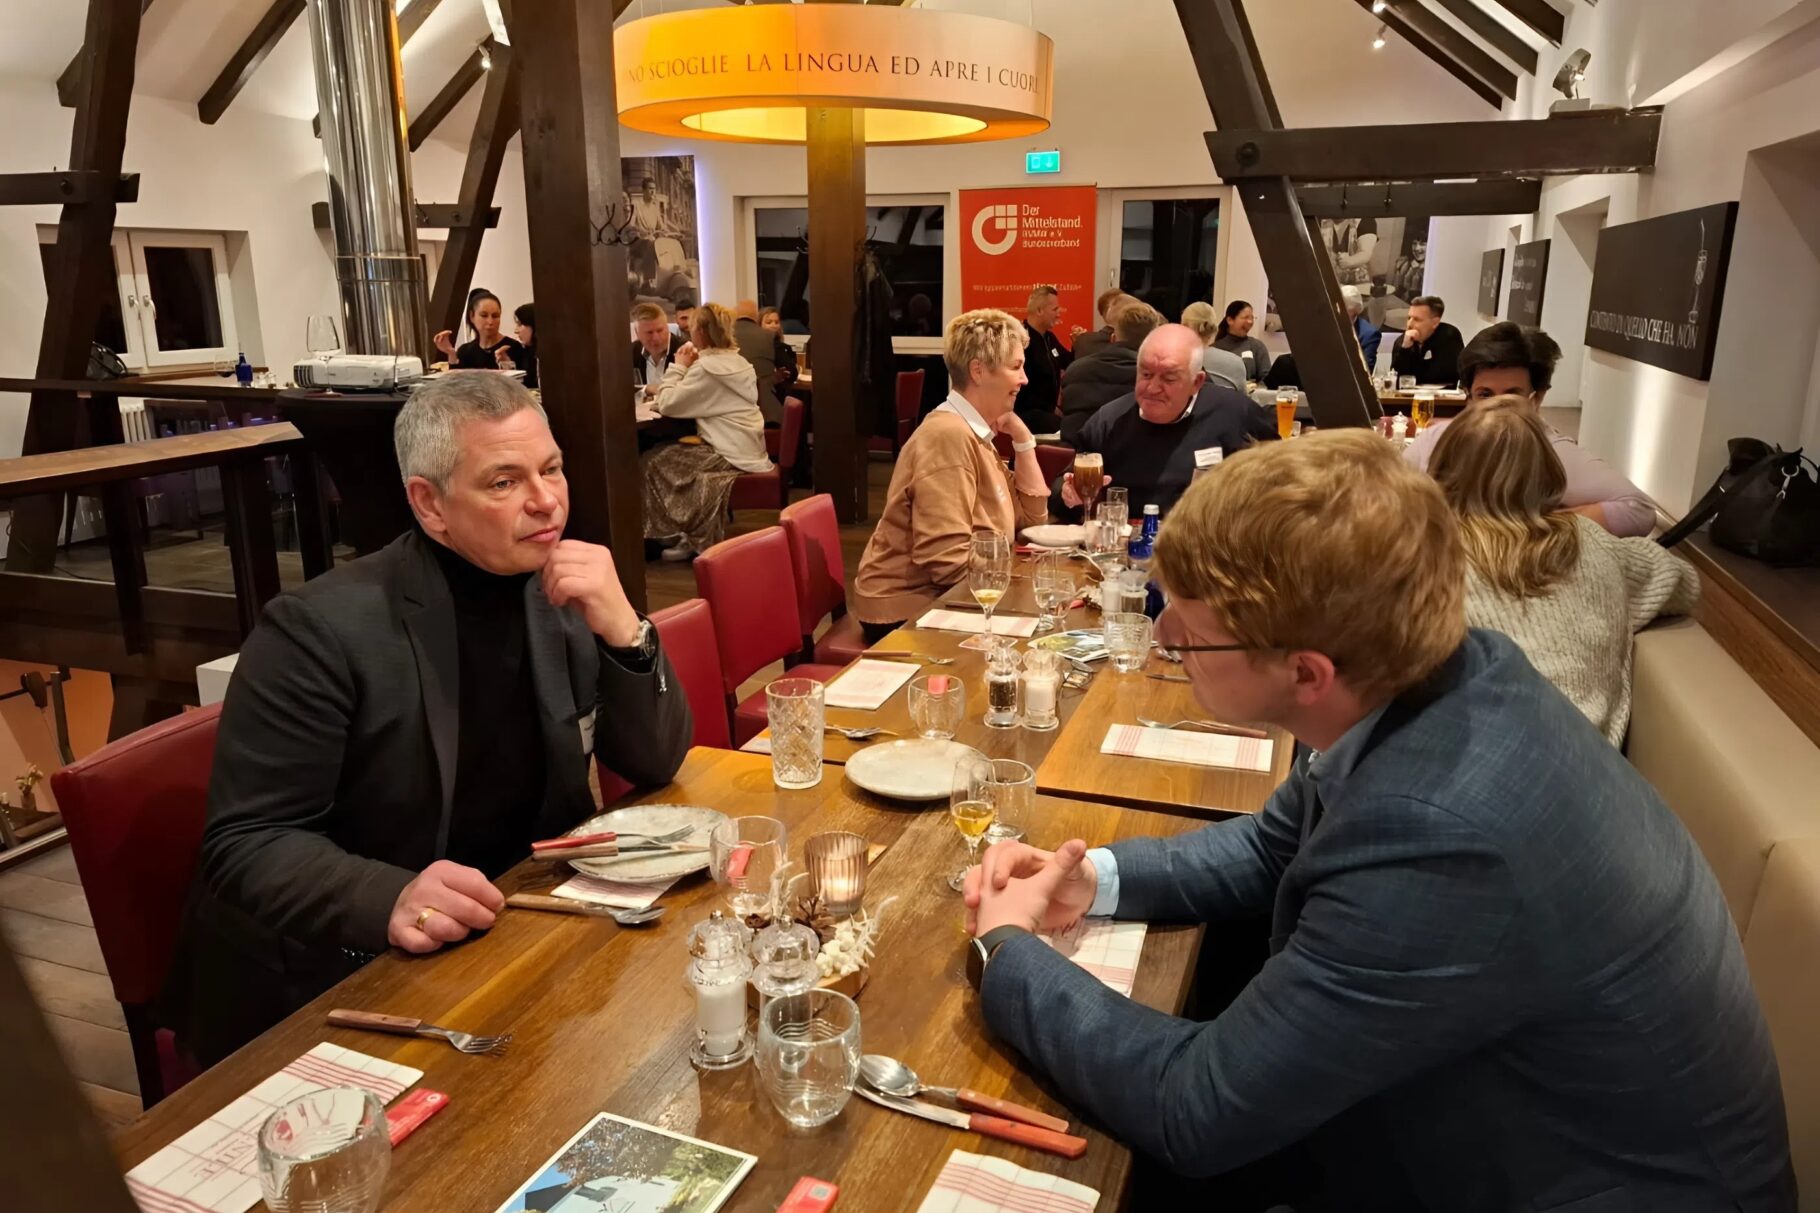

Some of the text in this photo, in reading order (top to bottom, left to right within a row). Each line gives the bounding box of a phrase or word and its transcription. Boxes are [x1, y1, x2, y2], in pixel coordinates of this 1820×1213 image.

[649, 55, 729, 80] SCIOGLIE
[747, 53, 771, 72] LA
[784, 52, 879, 73] LINGUA
[891, 55, 920, 75] ED
[929, 59, 979, 82] APRE
[987, 66, 991, 83] I
[1022, 204, 1040, 216] Der
[1676, 323, 1698, 350] NON
